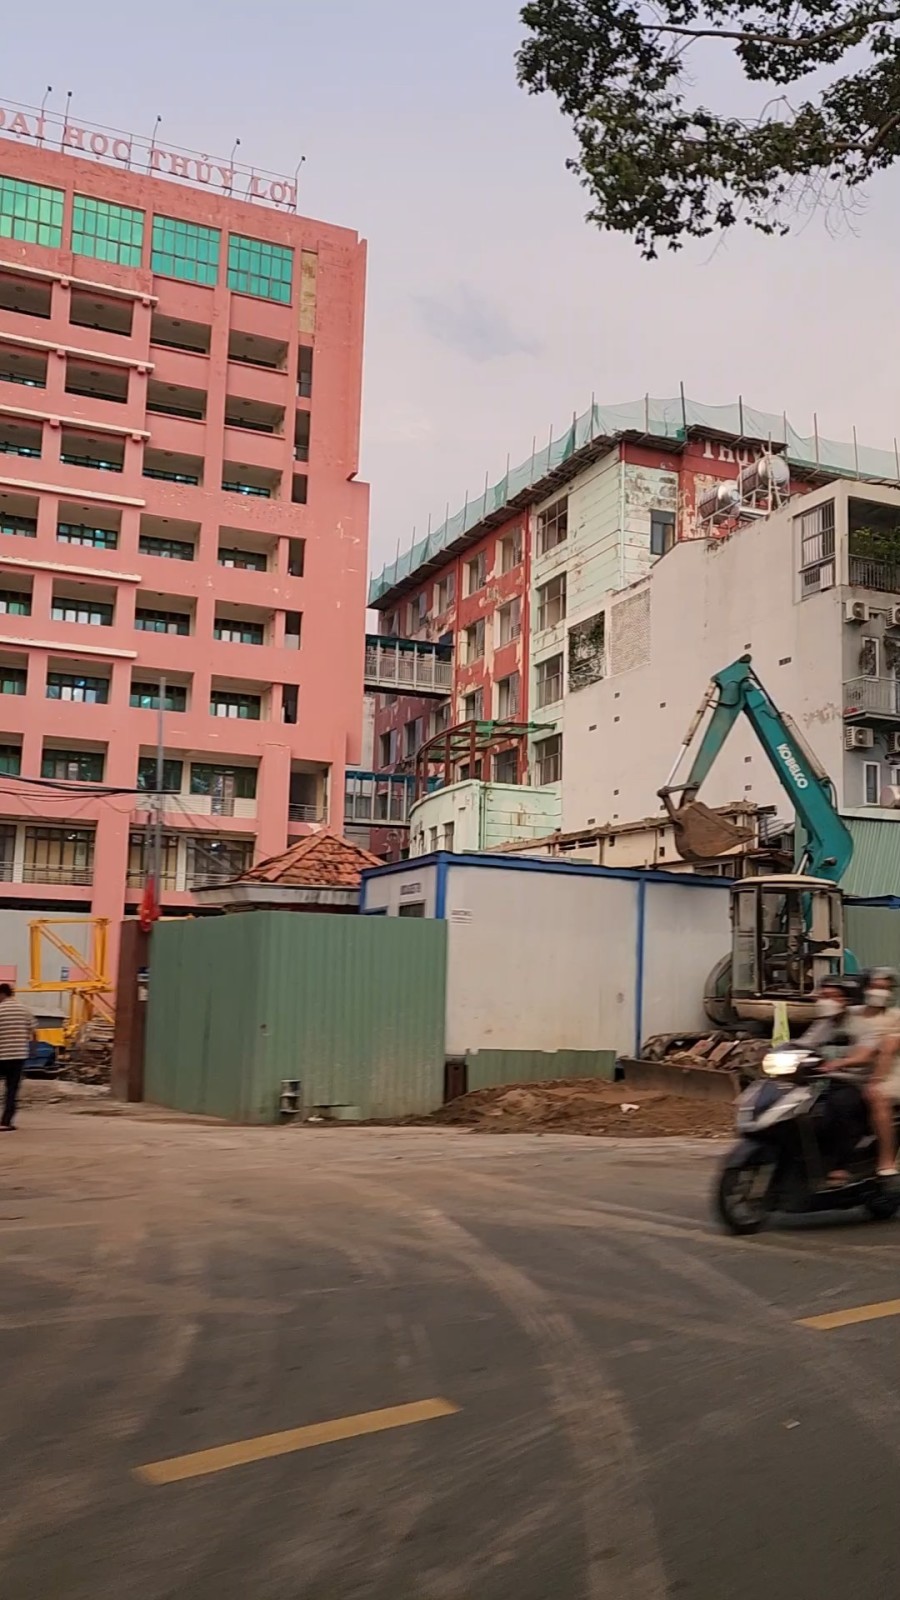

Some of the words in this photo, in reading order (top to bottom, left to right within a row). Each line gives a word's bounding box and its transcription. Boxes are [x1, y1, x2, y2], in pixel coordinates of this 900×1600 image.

[62, 125, 132, 164] HỌC
[147, 148, 237, 189] THỦY
[776, 743, 808, 789] KOBELCO
